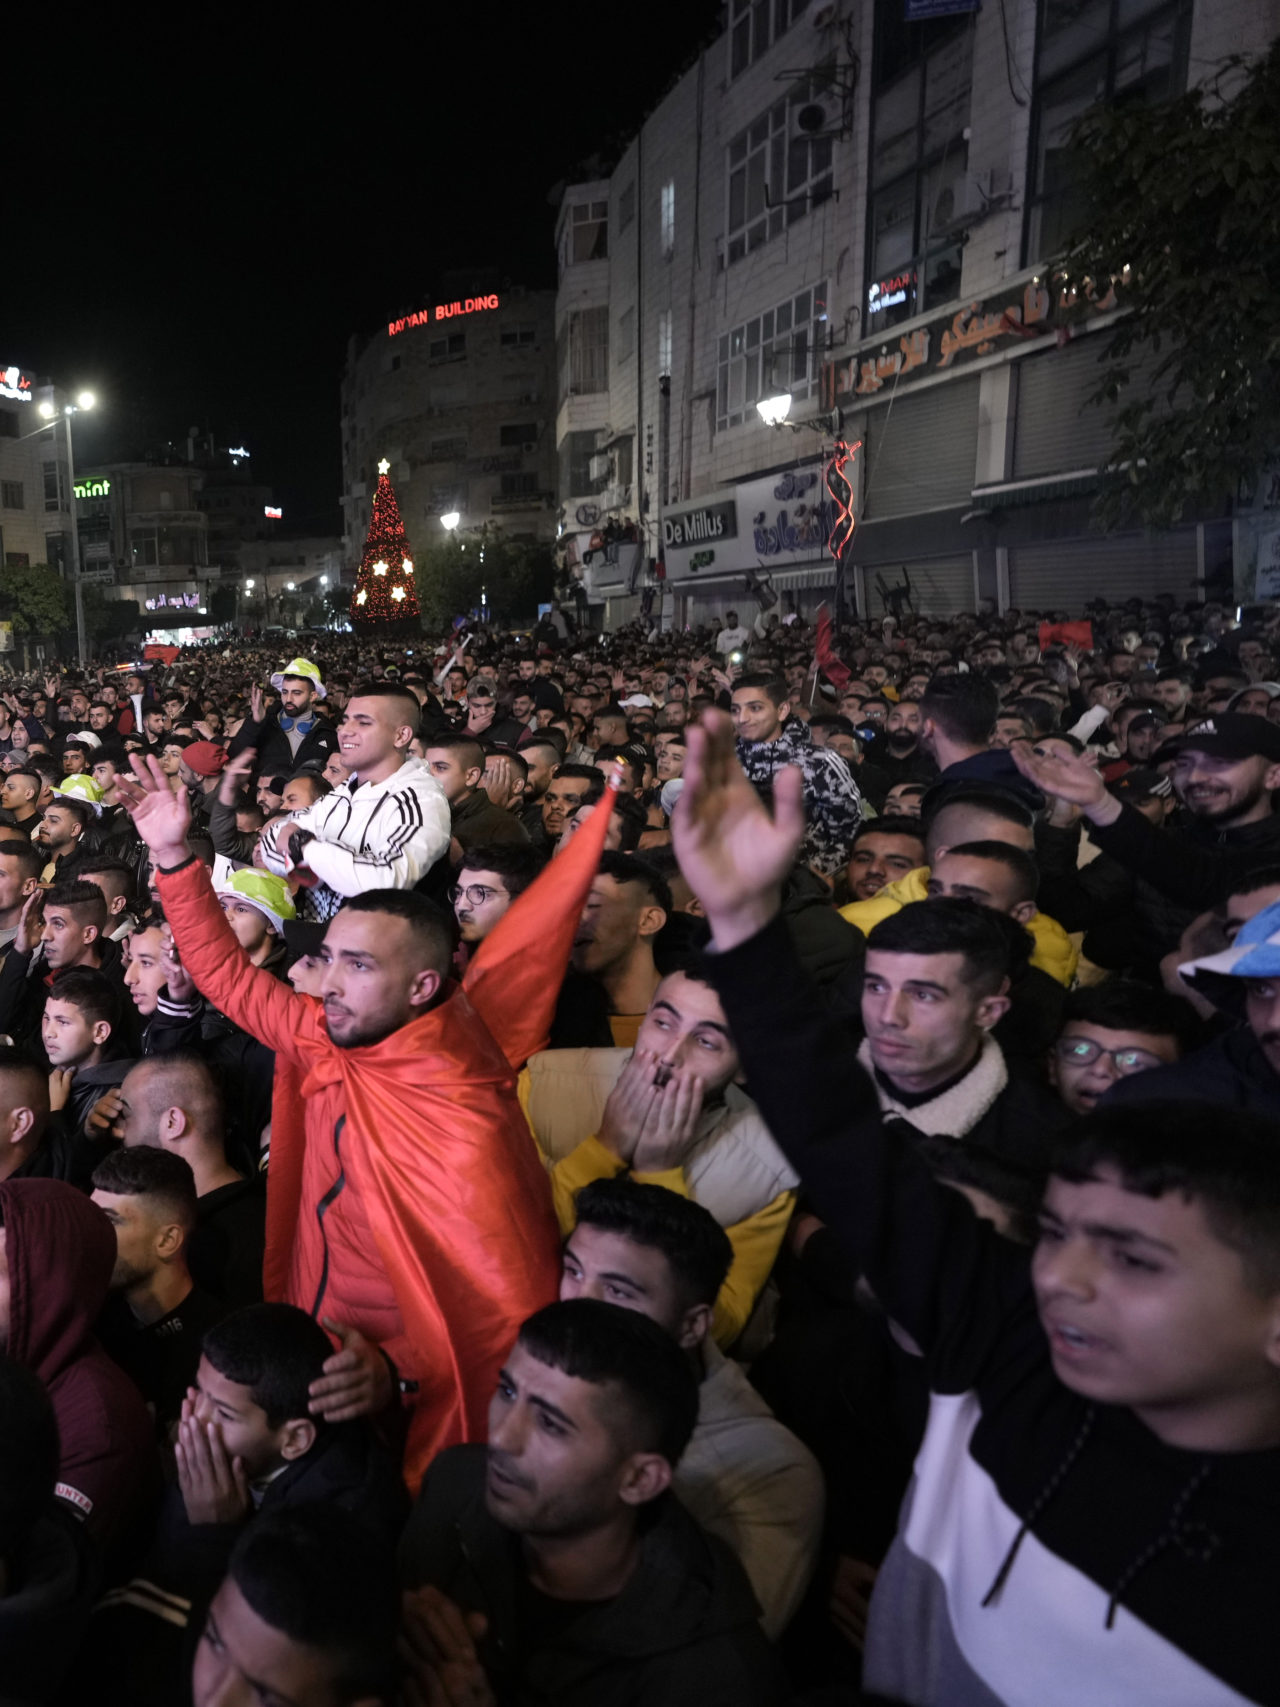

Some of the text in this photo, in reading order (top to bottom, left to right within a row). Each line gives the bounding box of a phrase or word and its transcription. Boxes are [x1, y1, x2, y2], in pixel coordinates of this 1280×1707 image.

[388, 293, 499, 337] RAYYAN BUILDING
[664, 510, 723, 545] De Millus
